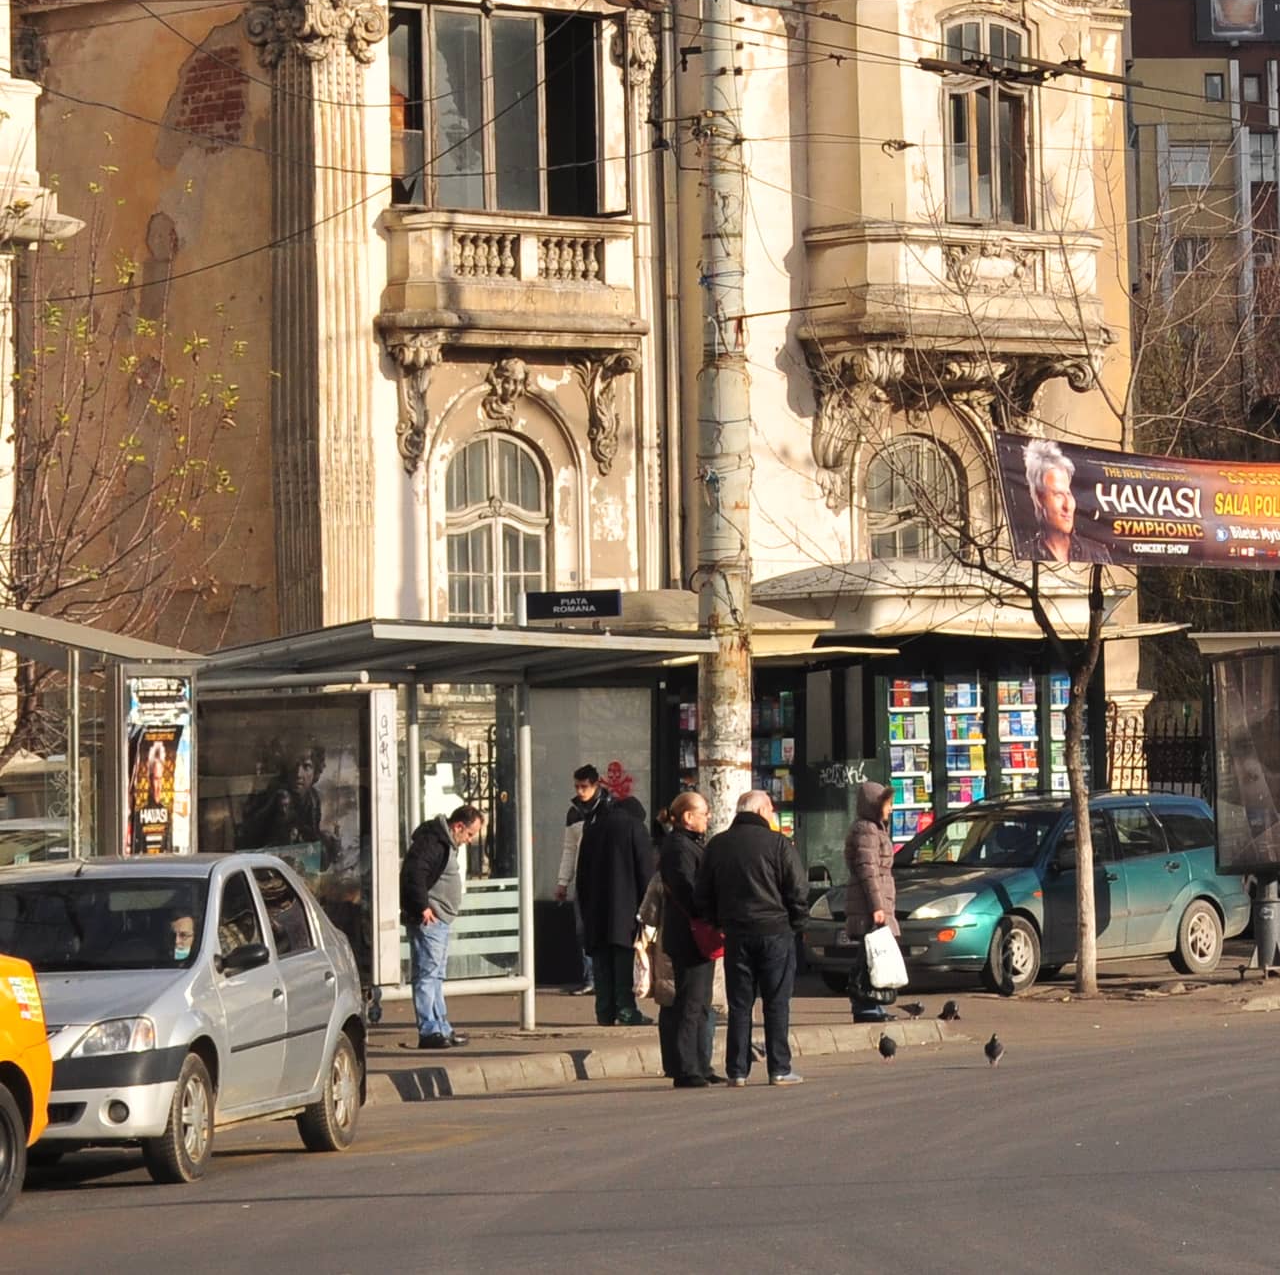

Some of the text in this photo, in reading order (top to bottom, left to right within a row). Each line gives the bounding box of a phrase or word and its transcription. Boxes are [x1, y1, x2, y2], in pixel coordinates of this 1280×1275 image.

[1096, 483, 1202, 518] HAVASI
[1215, 492, 1250, 516] SALA
[1113, 520, 1204, 537] SYMPHONIC
[1229, 526, 1260, 540] Bilete:
[1132, 543, 1190, 555] CONCERT SHOW
[560, 597, 588, 606] PIATA
[552, 605, 596, 614] ROMANA
